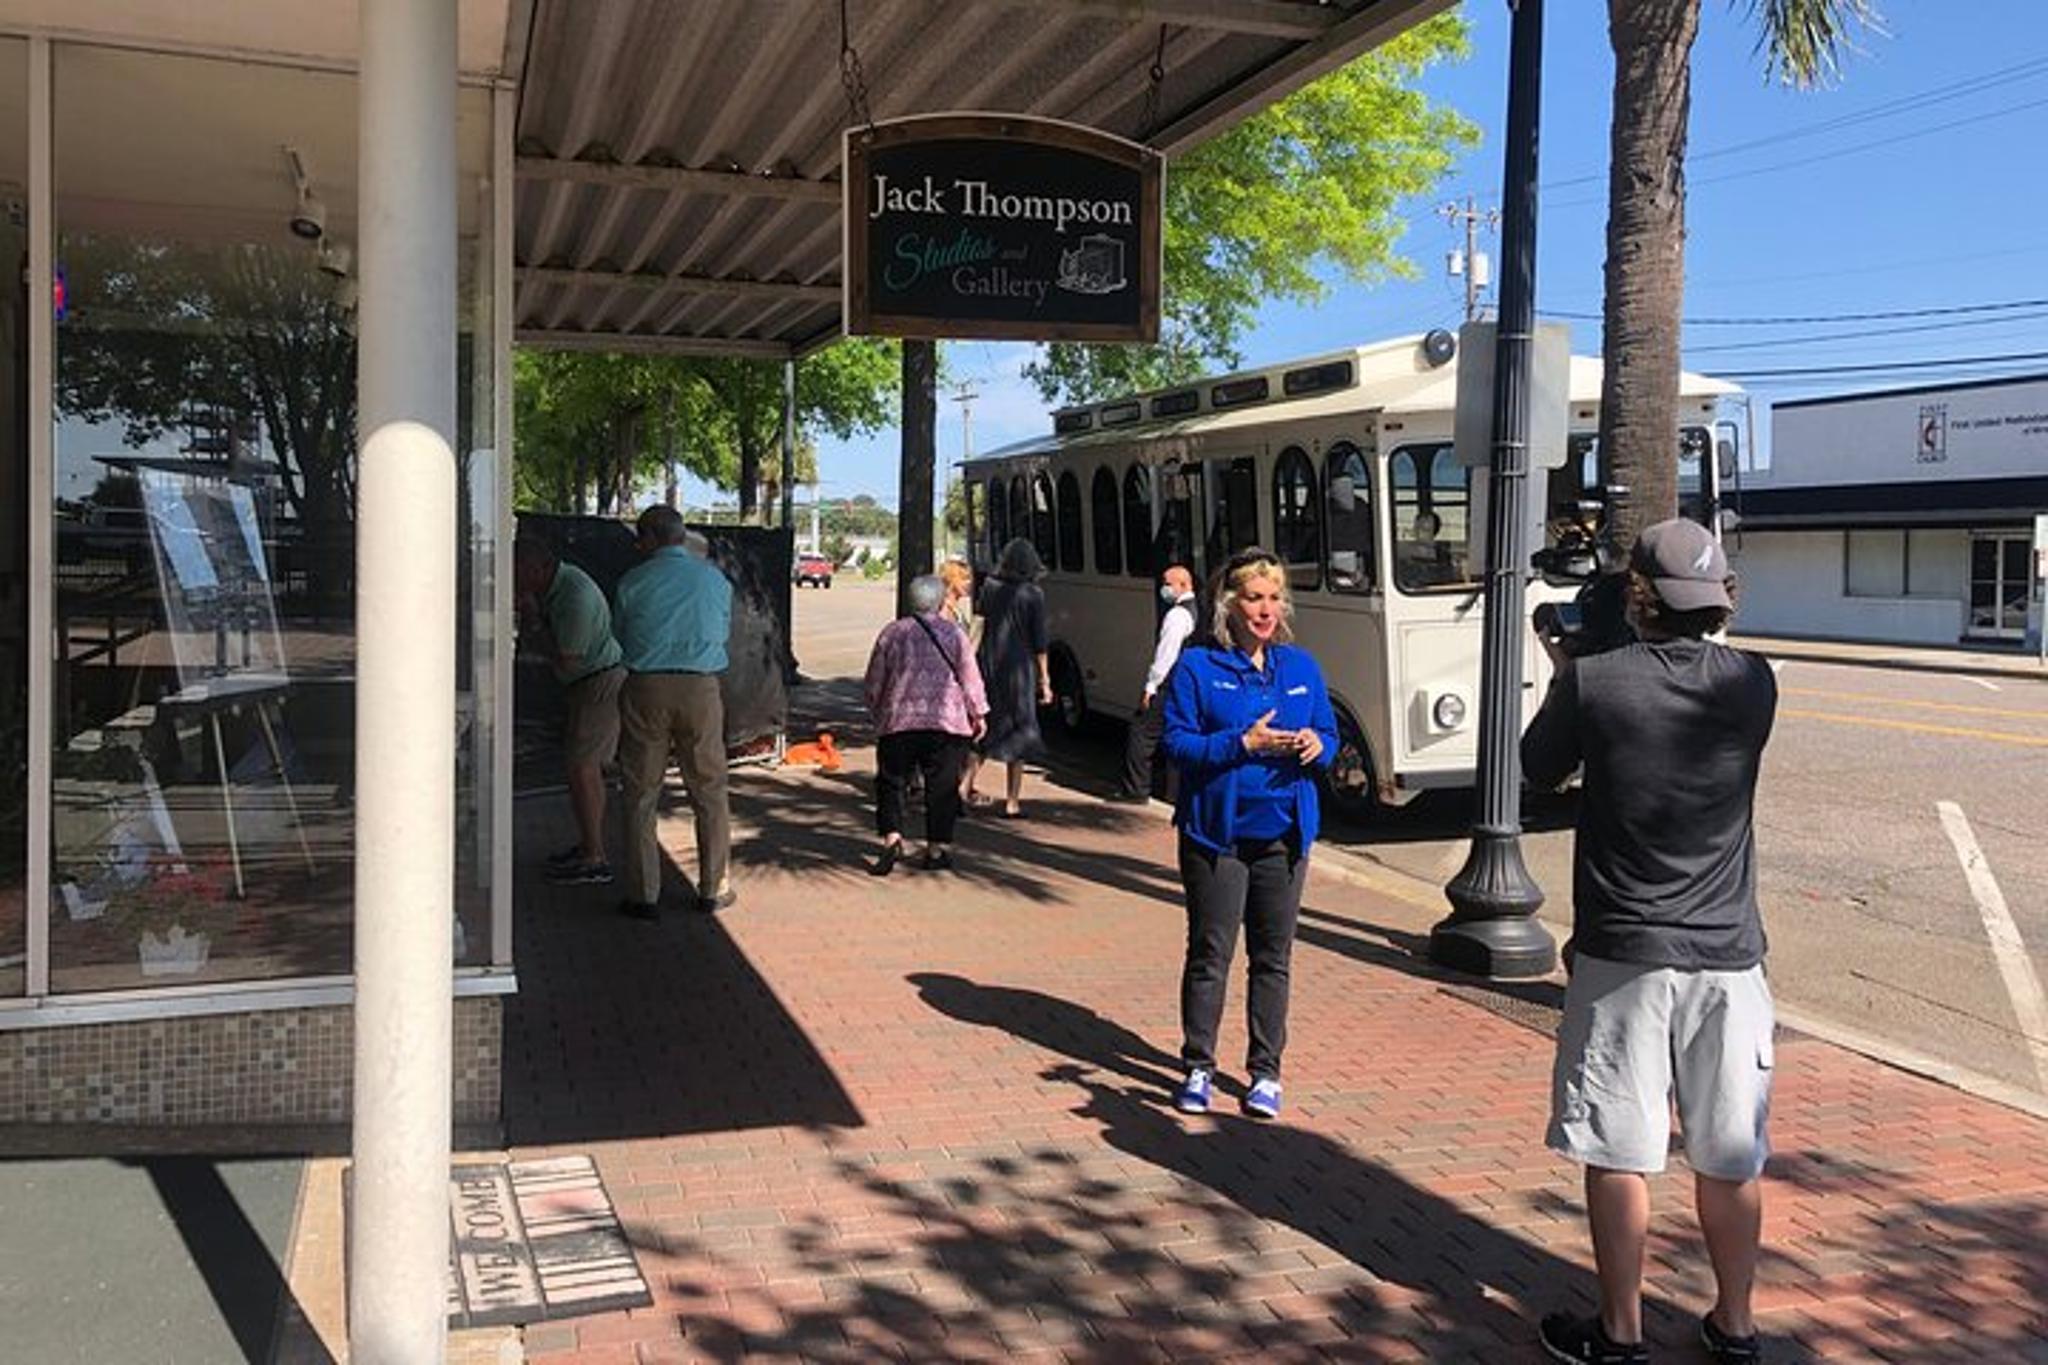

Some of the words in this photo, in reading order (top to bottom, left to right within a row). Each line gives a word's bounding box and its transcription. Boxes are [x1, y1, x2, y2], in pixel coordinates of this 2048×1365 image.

[869, 175, 947, 220] Jack
[953, 179, 1133, 233] Thompson
[883, 227, 995, 291] Studios
[951, 265, 1050, 308] Gallery
